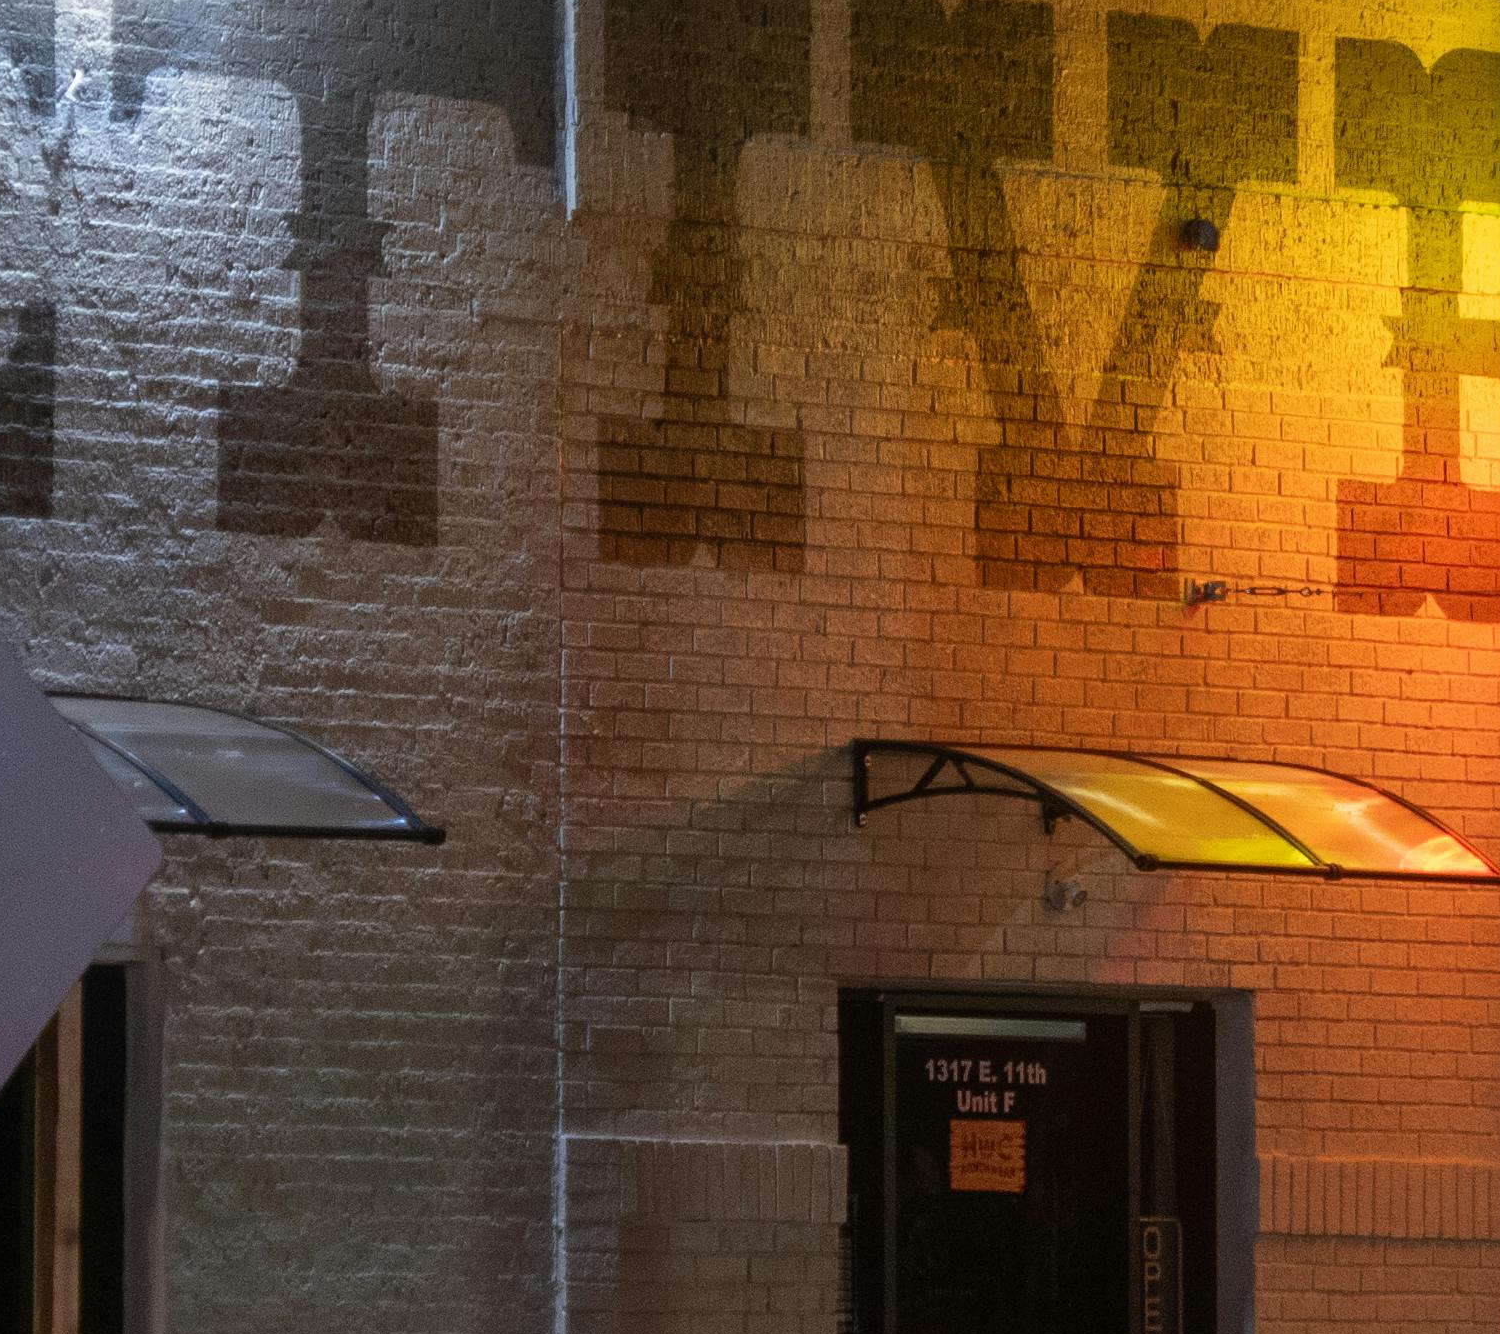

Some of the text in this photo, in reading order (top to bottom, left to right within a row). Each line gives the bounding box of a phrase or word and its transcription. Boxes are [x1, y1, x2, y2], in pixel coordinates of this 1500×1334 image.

[924, 1058, 973, 1082] 1317
[1003, 1060, 1047, 1085] 11th
[956, 1089, 1016, 1114] Unit F
